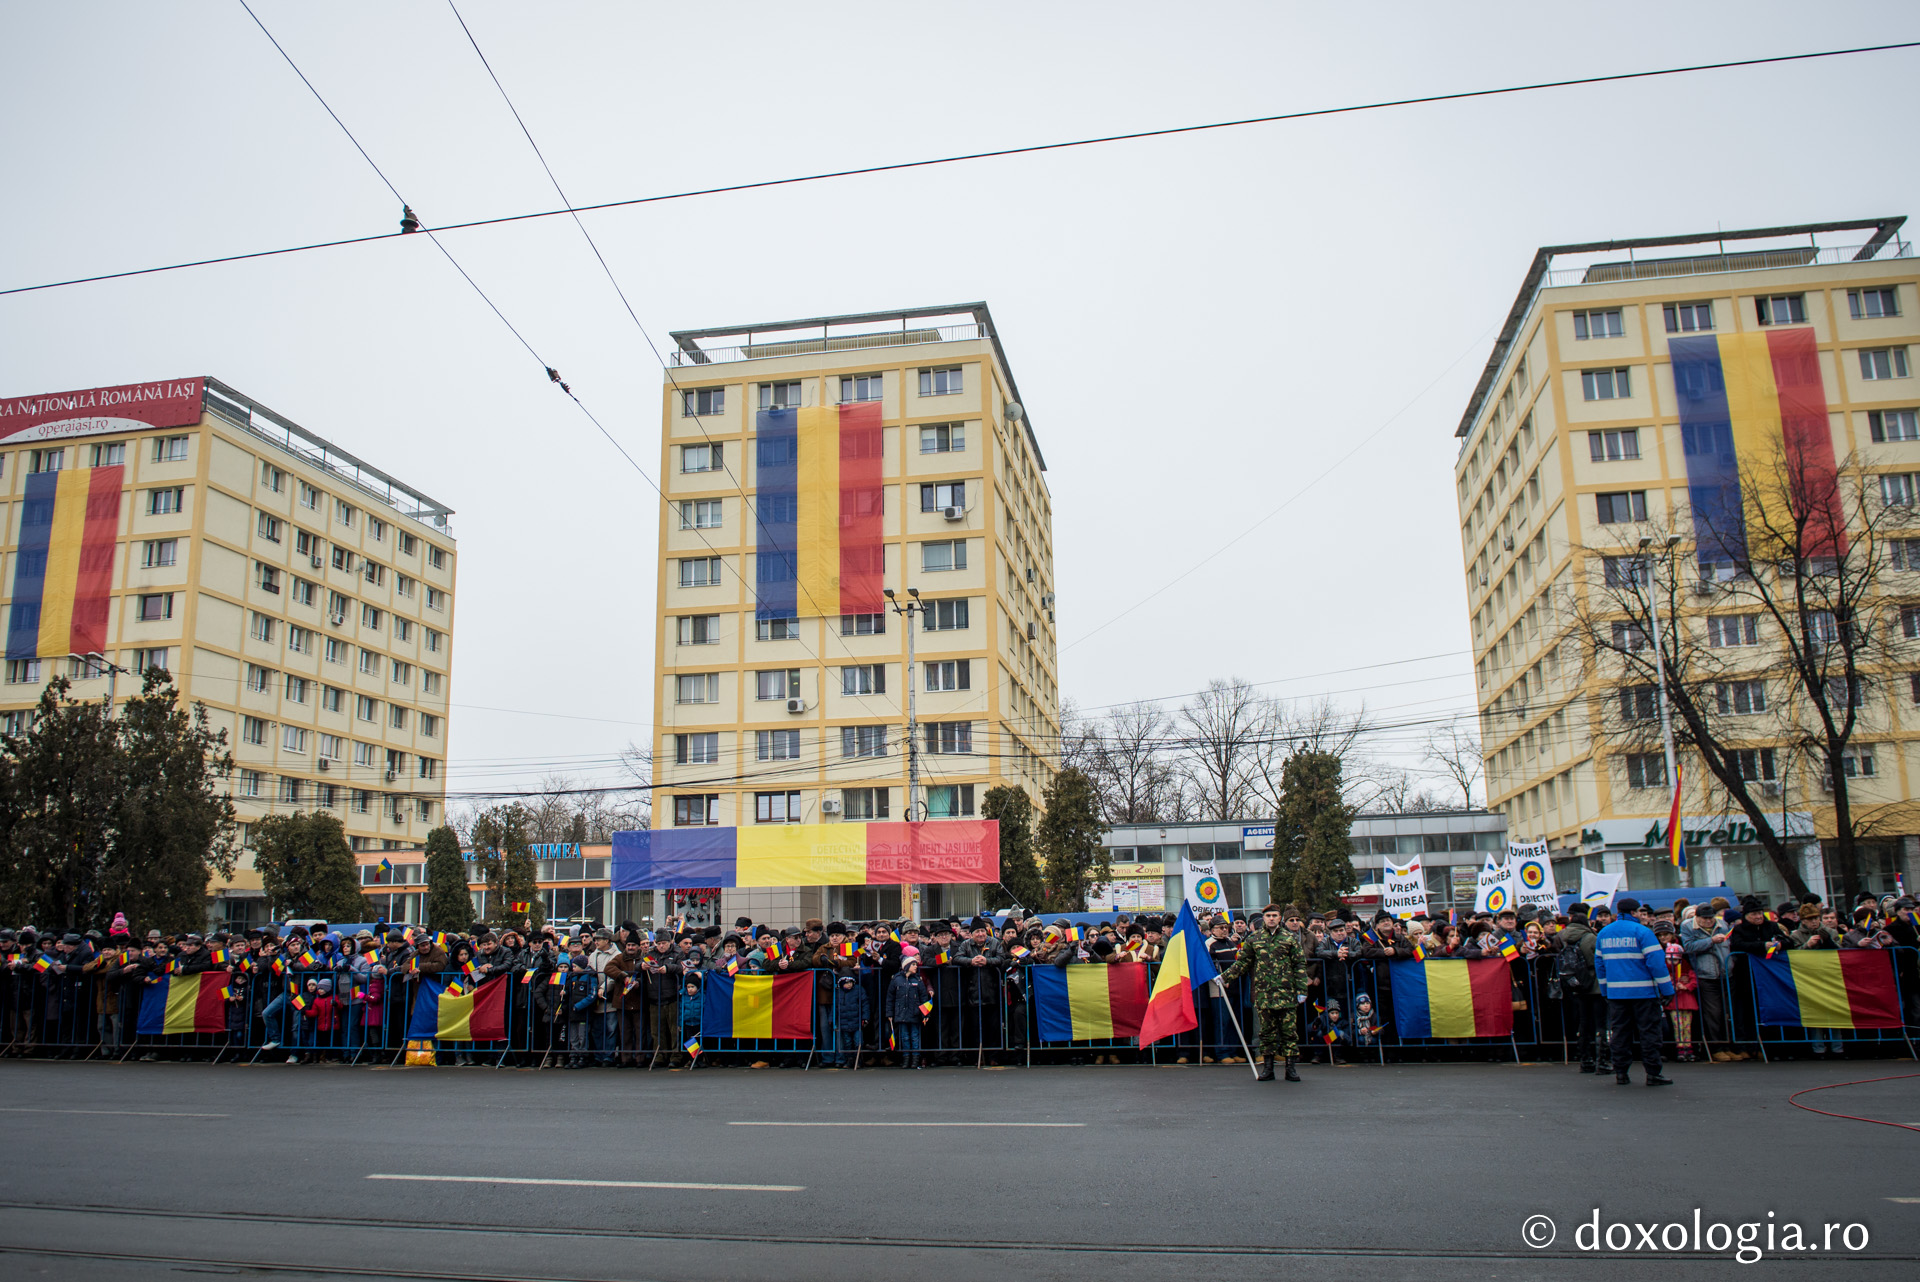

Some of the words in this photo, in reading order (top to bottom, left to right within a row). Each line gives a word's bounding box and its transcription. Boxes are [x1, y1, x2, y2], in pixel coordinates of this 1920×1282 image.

[100, 383, 164, 406] ROMÂNĂ
[527, 842, 582, 860] NIMEA
[1509, 844, 1547, 858] UNIREA
[867, 858, 895, 870] REAL
[896, 857, 935, 870] ESTE
[938, 856, 982, 869] AGENCY
[1480, 868, 1512, 886] UNIREA
[1389, 880, 1420, 893] VREM
[1384, 894, 1426, 908] UNIREA
[1519, 892, 1555, 903] OBIECTIV
